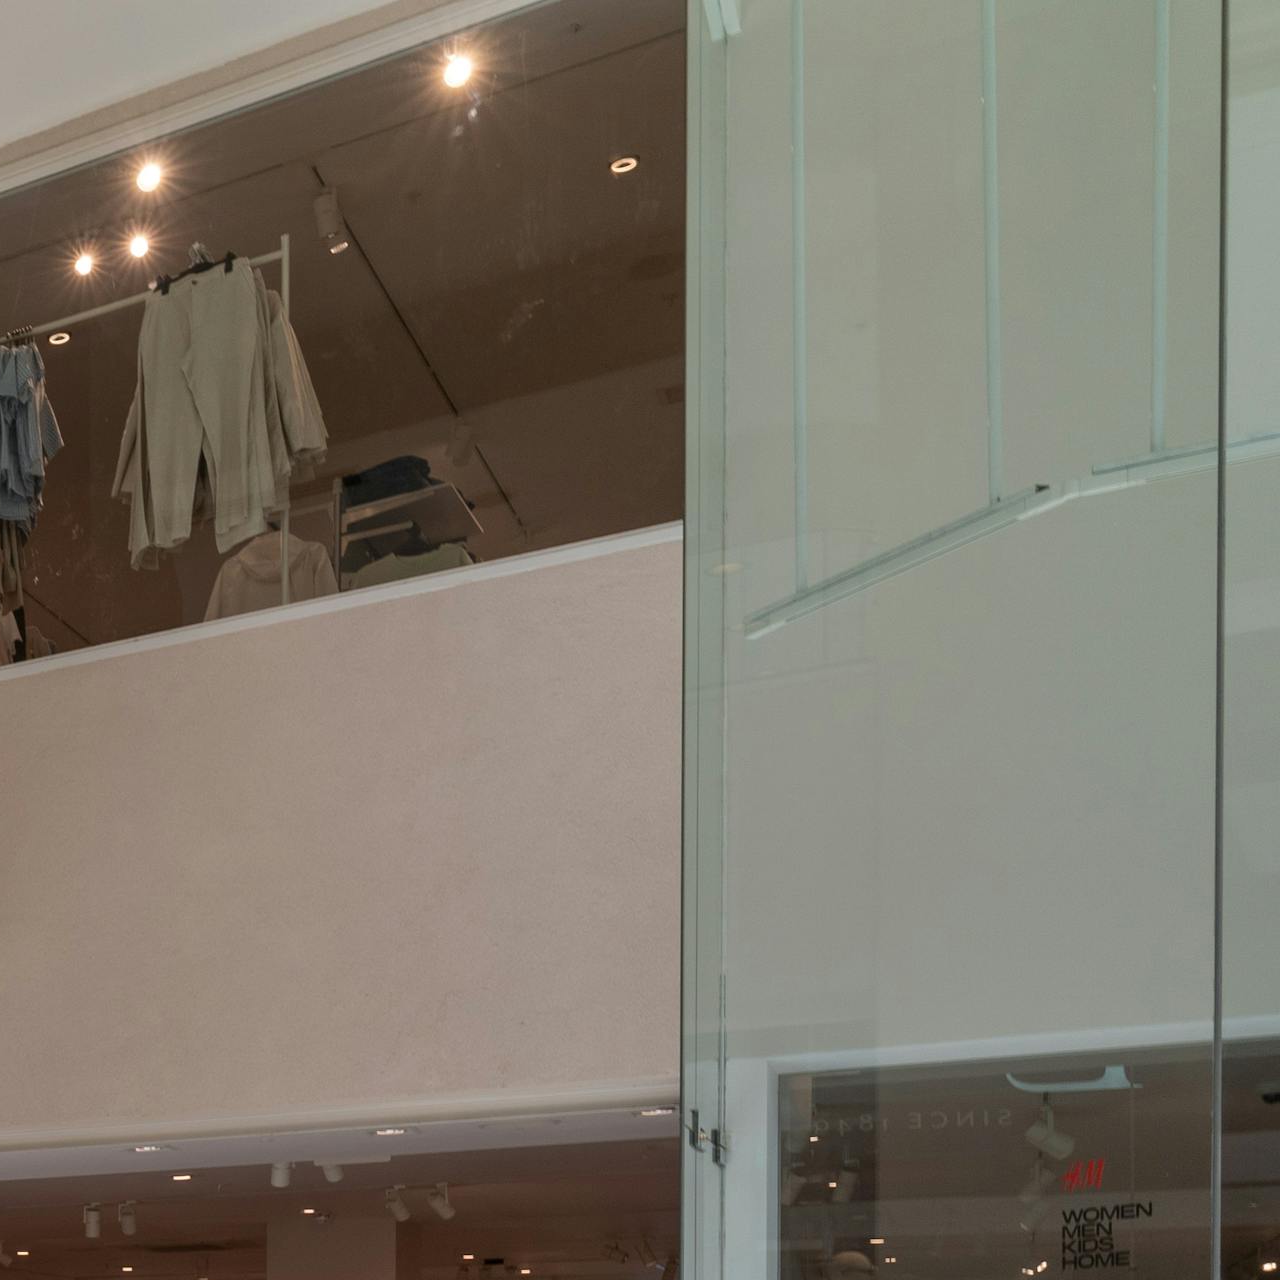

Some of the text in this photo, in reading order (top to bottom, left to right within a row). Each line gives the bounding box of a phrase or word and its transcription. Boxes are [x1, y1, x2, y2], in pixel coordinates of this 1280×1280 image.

[1061, 1202, 1153, 1224] WOMEN
[1061, 1221, 1113, 1240] MEN
[1061, 1237, 1114, 1254] KIDS
[1061, 1251, 1131, 1272] HOME
